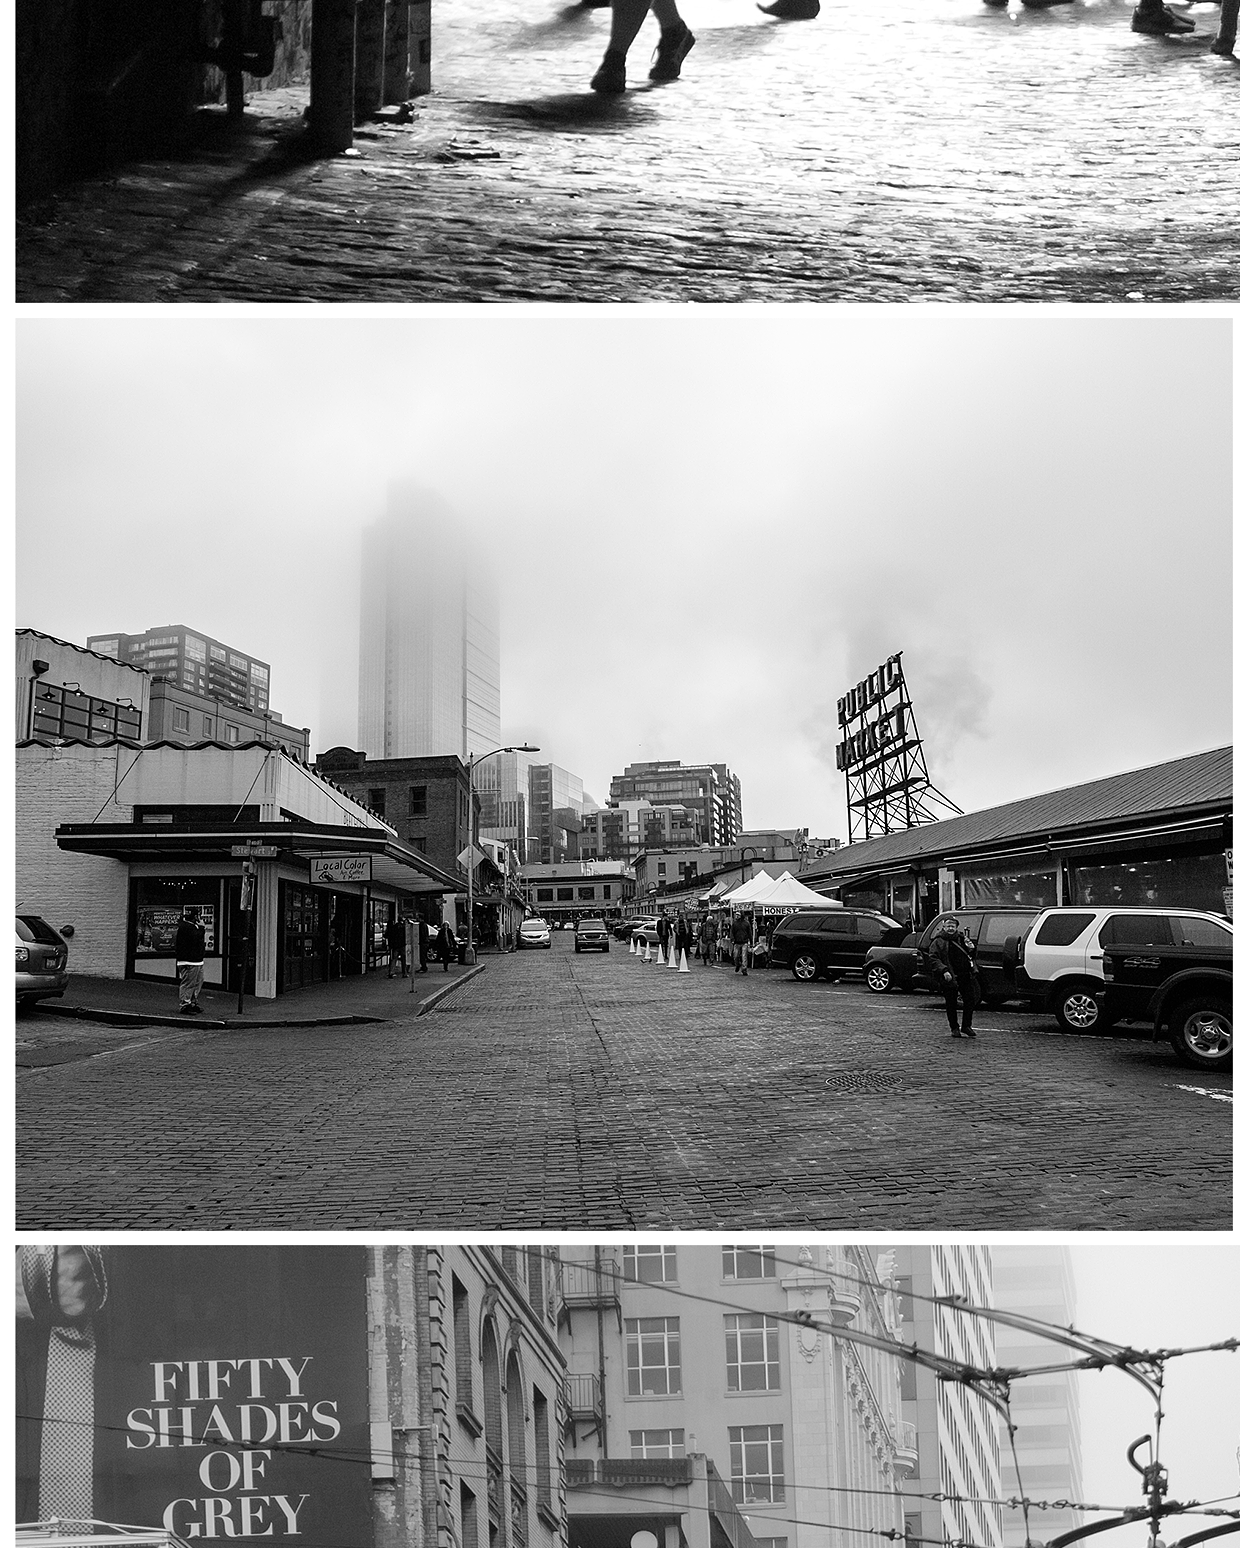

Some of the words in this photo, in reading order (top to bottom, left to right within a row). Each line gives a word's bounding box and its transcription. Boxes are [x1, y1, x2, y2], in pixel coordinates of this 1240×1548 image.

[837, 654, 901, 725] PUBLIC
[836, 702, 905, 770] MARKET
[315, 860, 342, 872] Local
[344, 859, 367, 870] Color
[150, 1357, 313, 1402] FIFTY
[126, 1401, 341, 1449] SHADES
[199, 1450, 271, 1492] OF
[163, 1494, 310, 1539] GREY
